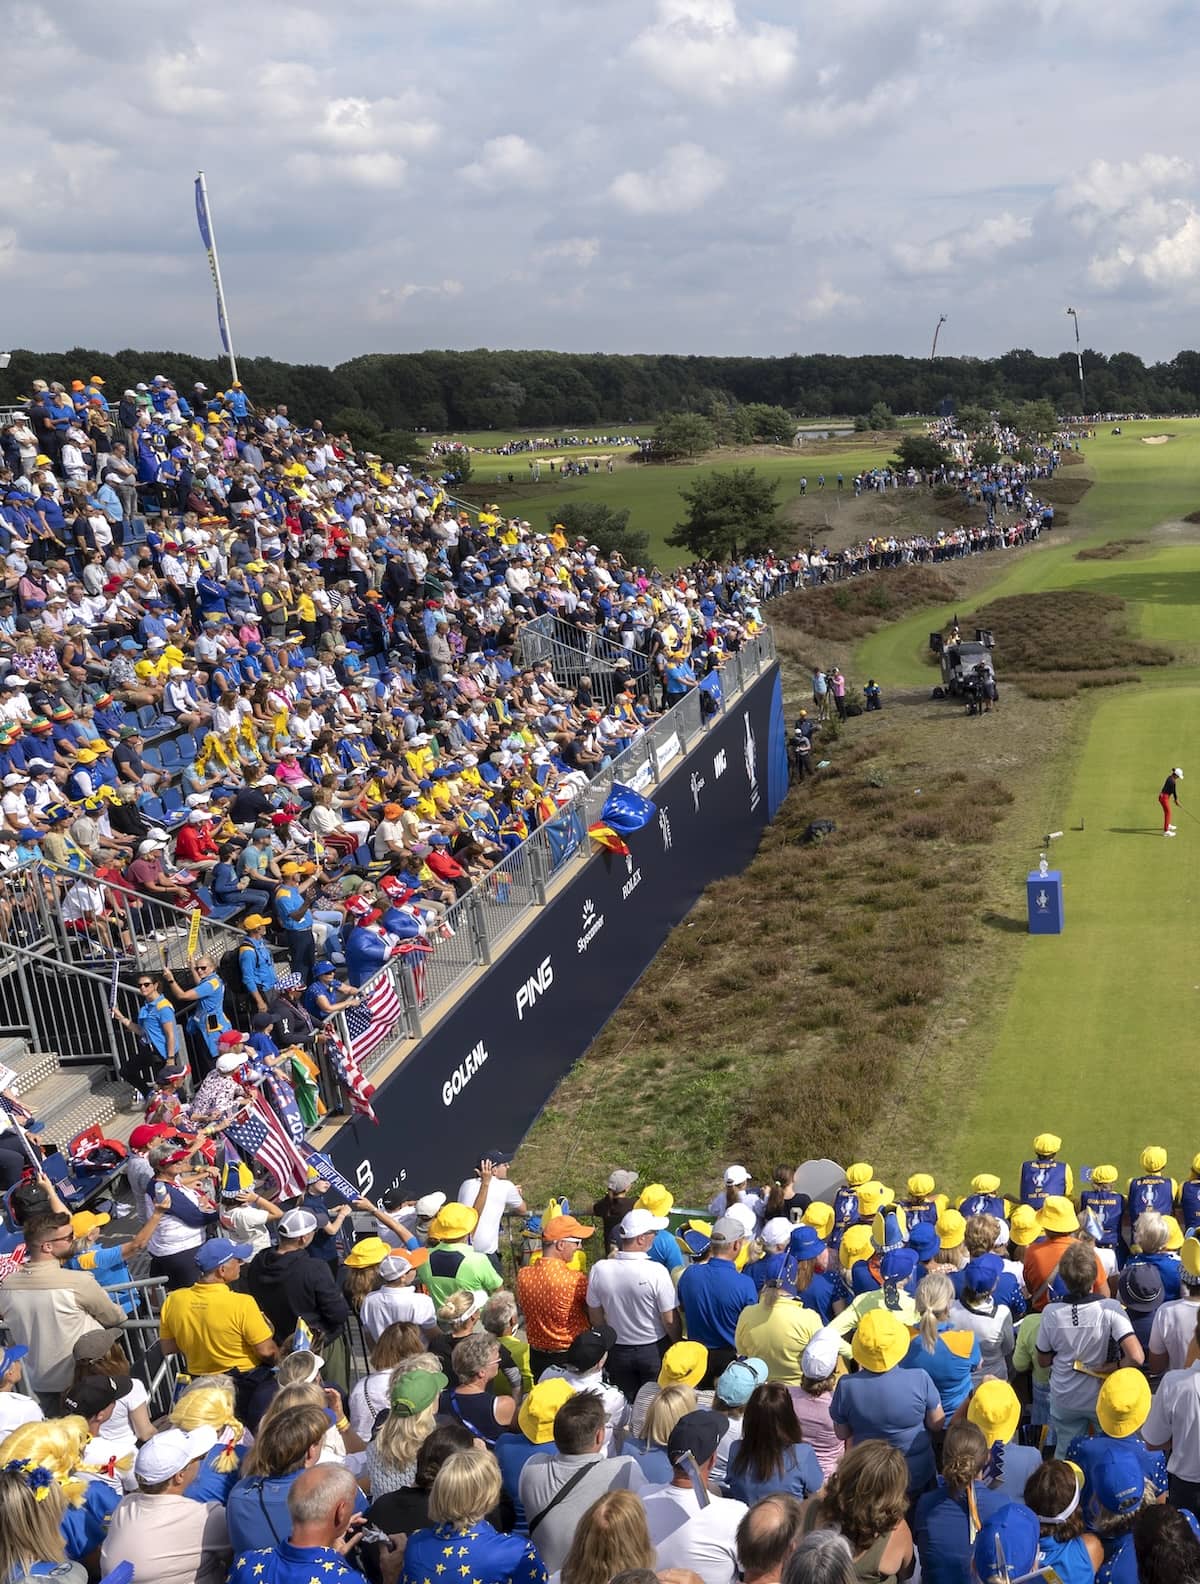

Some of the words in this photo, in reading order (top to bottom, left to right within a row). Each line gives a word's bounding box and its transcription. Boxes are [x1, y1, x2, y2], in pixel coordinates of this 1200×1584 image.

[622, 867, 642, 900] ROLEX
[516, 954, 554, 1021] PING
[442, 1040, 489, 1107] GOLF.NL
[315, 1162, 335, 1181] QUIET
[331, 1176, 356, 1199] PLEASE
